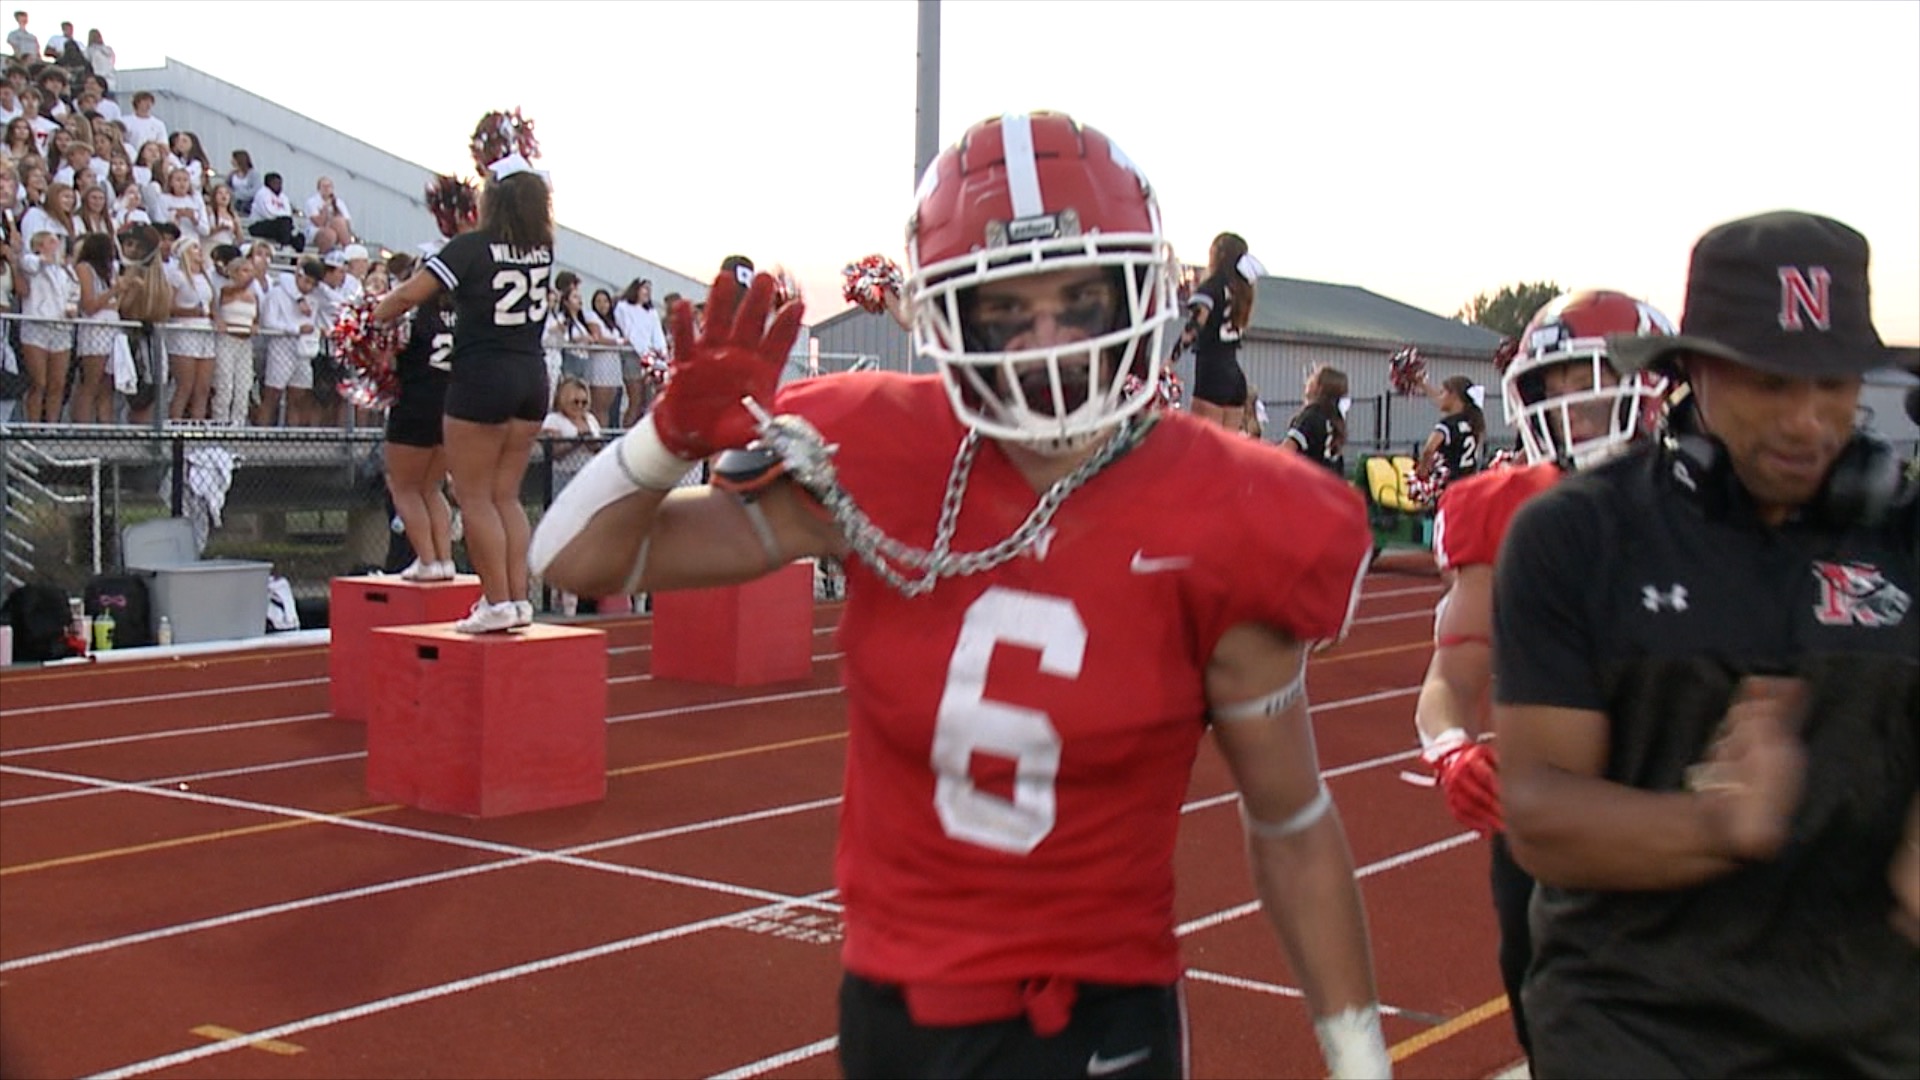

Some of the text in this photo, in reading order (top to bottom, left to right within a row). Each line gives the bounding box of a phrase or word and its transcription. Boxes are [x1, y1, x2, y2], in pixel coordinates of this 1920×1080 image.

[492, 266, 550, 326] 25
[1777, 265, 1832, 332] N
[930, 584, 1088, 857] 6
